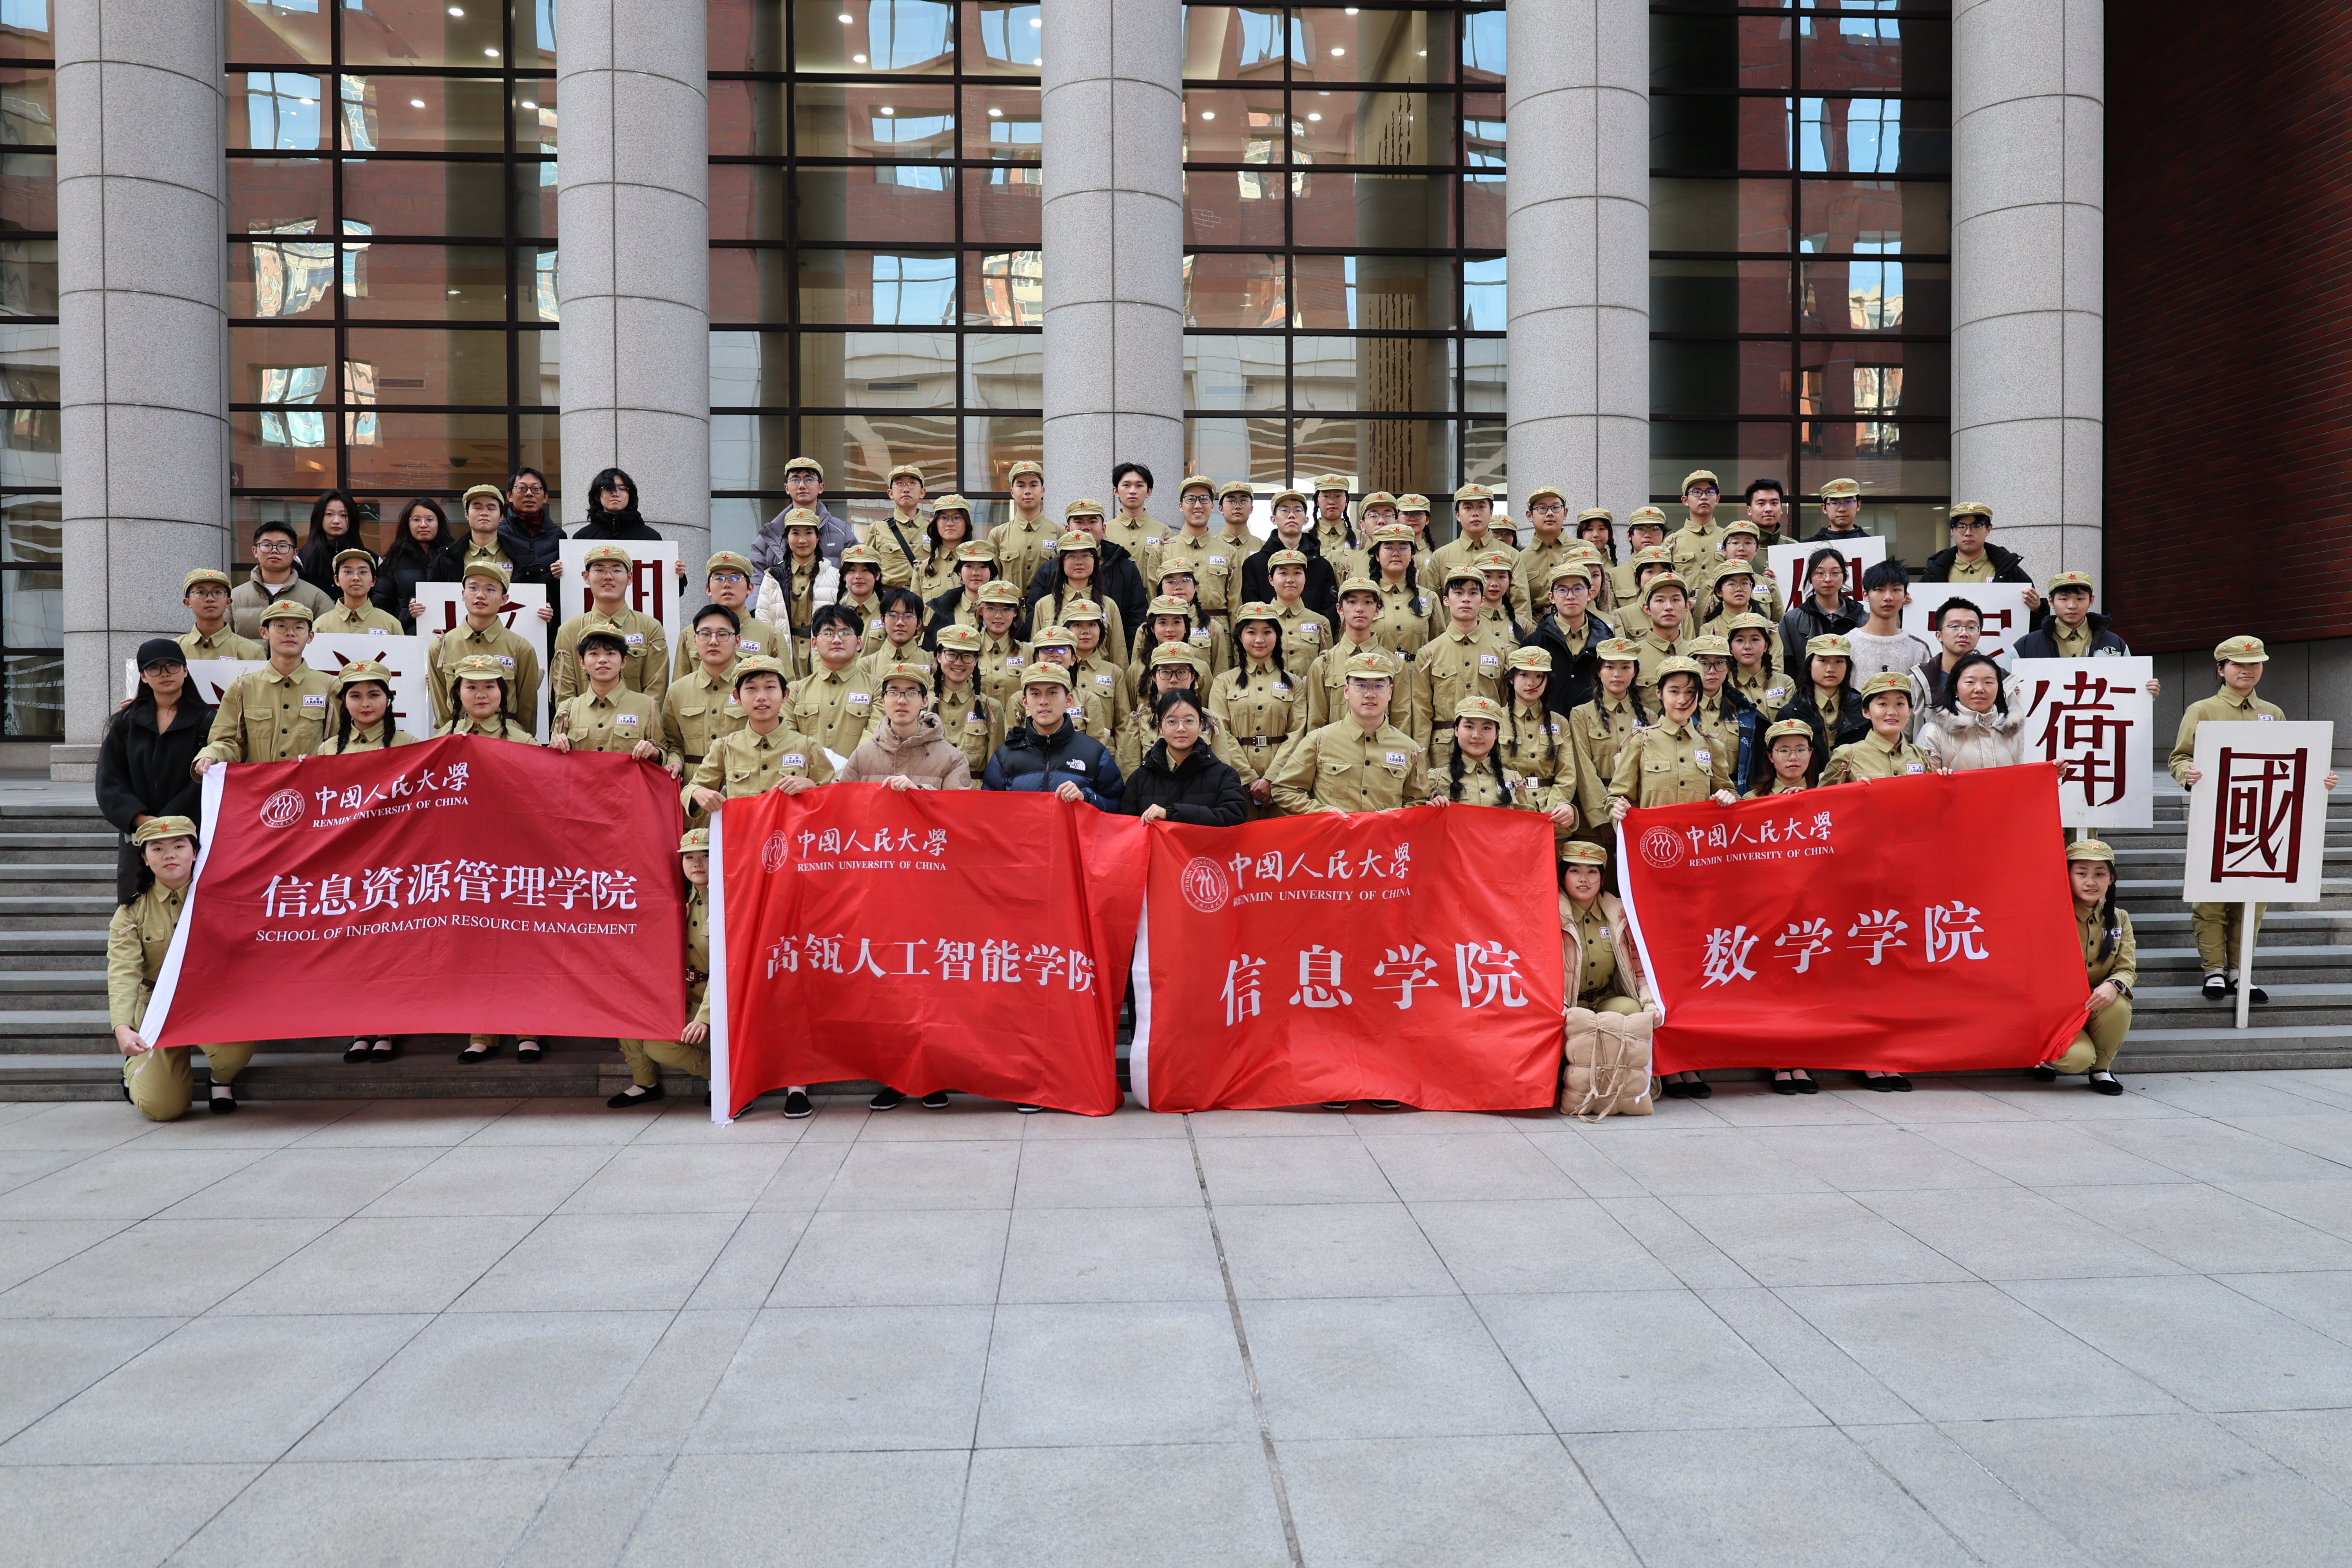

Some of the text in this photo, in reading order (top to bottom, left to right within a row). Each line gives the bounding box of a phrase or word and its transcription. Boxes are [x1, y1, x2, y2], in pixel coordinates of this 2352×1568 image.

[2026, 671, 2136, 806] 衛
[316, 762, 469, 815] 中國人民大學
[313, 816, 354, 827] RENMIN
[354, 803, 412, 819] UNIVERSITY
[436, 797, 468, 806] CHINA
[1647, 828, 1671, 837] UNIVERSITY
[1686, 811, 1832, 854] 中國人民大學
[2210, 747, 2308, 883] 國
[798, 828, 947, 859] 中國人民大學
[1690, 857, 1721, 866] RENMIN
[1727, 851, 1782, 861] UNIVERSITY
[1804, 847, 1834, 855] CHINA
[261, 859, 637, 917] 信息资源管理学院
[798, 862, 833, 871] RENMIN
[839, 861, 895, 869] UNIVERSITY
[916, 862, 946, 870] CHINA
[1229, 843, 1410, 889] 中國人民大學
[1234, 888, 1410, 906] RENMIN UNIVERSITY OF CHINA
[256, 915, 637, 941] SCHOOL OF INFORMATION RESOURCE MANAGEMENT
[1701, 901, 1989, 989] 数学学院
[766, 934, 1095, 995] 高瓴人工智能学院
[1220, 940, 1528, 1026] 信息学院
